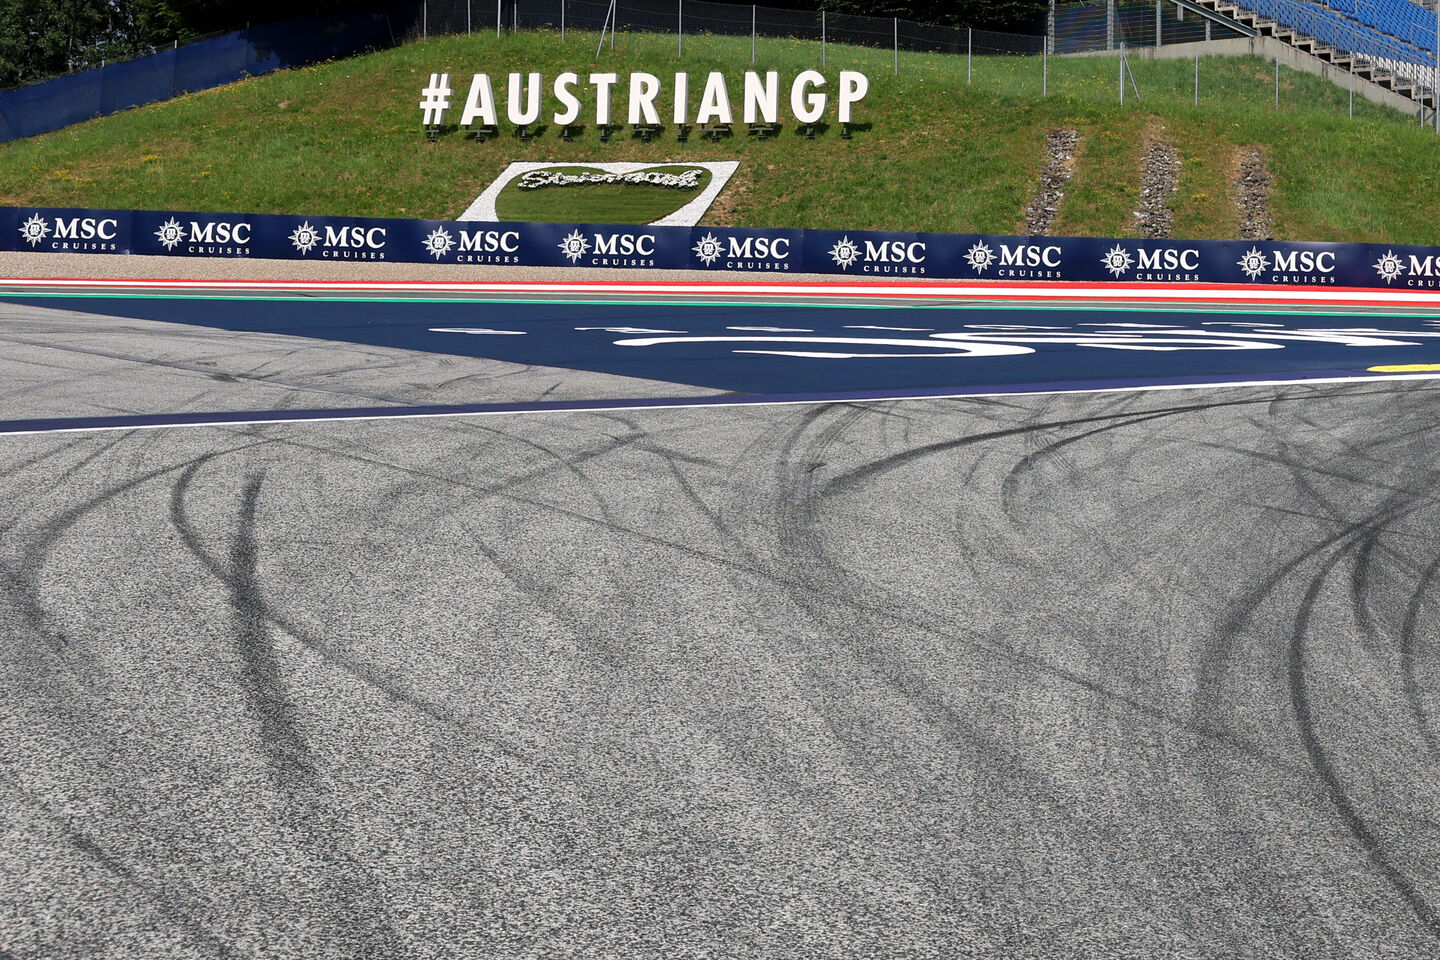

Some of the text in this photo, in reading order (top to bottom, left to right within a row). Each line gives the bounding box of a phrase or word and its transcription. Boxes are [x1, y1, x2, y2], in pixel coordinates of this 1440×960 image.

[419, 70, 869, 126] #AUSTRIANGP
[53, 218, 117, 239] MSC
[189, 221, 251, 243] MSC
[324, 226, 386, 248] MSC
[52, 242, 116, 250] CRUISES
[188, 246, 250, 254] CRUISES
[457, 230, 520, 252] MSC
[593, 233, 656, 255] MSC
[728, 237, 790, 259] MSC
[323, 251, 386, 259] CRUISES
[456, 255, 519, 263] CRUISES
[592, 258, 656, 266] CRUISES
[863, 241, 926, 263] MSC
[998, 245, 1062, 267] MSC
[1136, 248, 1199, 270] MSC
[1272, 251, 1336, 273] MSC
[727, 262, 790, 270] CRUISES
[863, 266, 925, 274] CRUISES
[998, 269, 1062, 278] CRUISES
[1135, 273, 1198, 281] CRUISES
[1272, 276, 1335, 284] CRUISES
